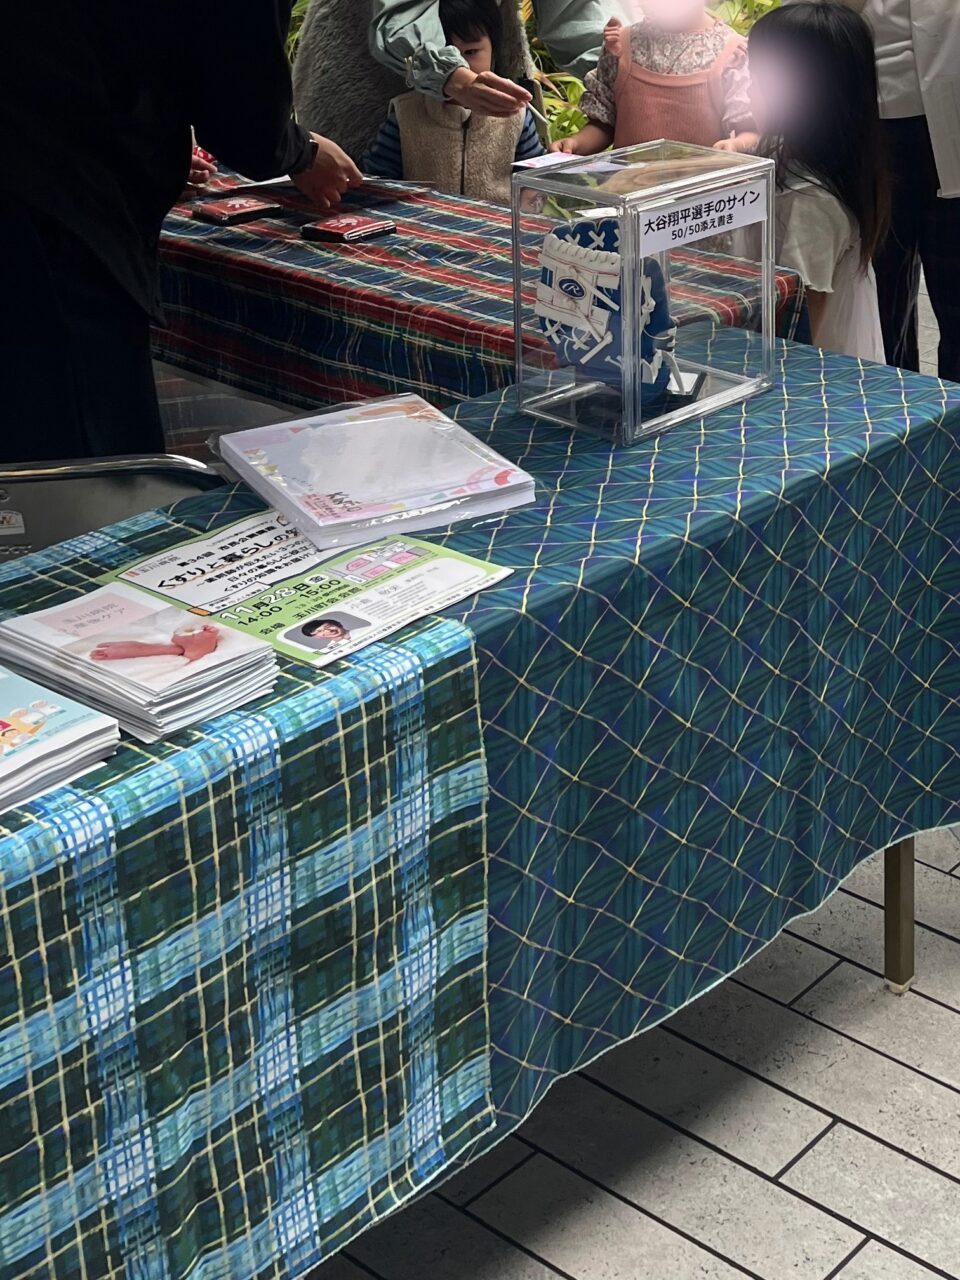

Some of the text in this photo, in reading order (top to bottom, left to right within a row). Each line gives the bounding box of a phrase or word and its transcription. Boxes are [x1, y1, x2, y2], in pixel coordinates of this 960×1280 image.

[644, 190, 761, 236] 大谷翔平選手のサイン
[671, 213, 734, 241] 50/50添え書き
[220, 583, 311, 621] 11月28日
[238, 605, 283, 626] 14:00
[299, 579, 341, 600] 15:00
